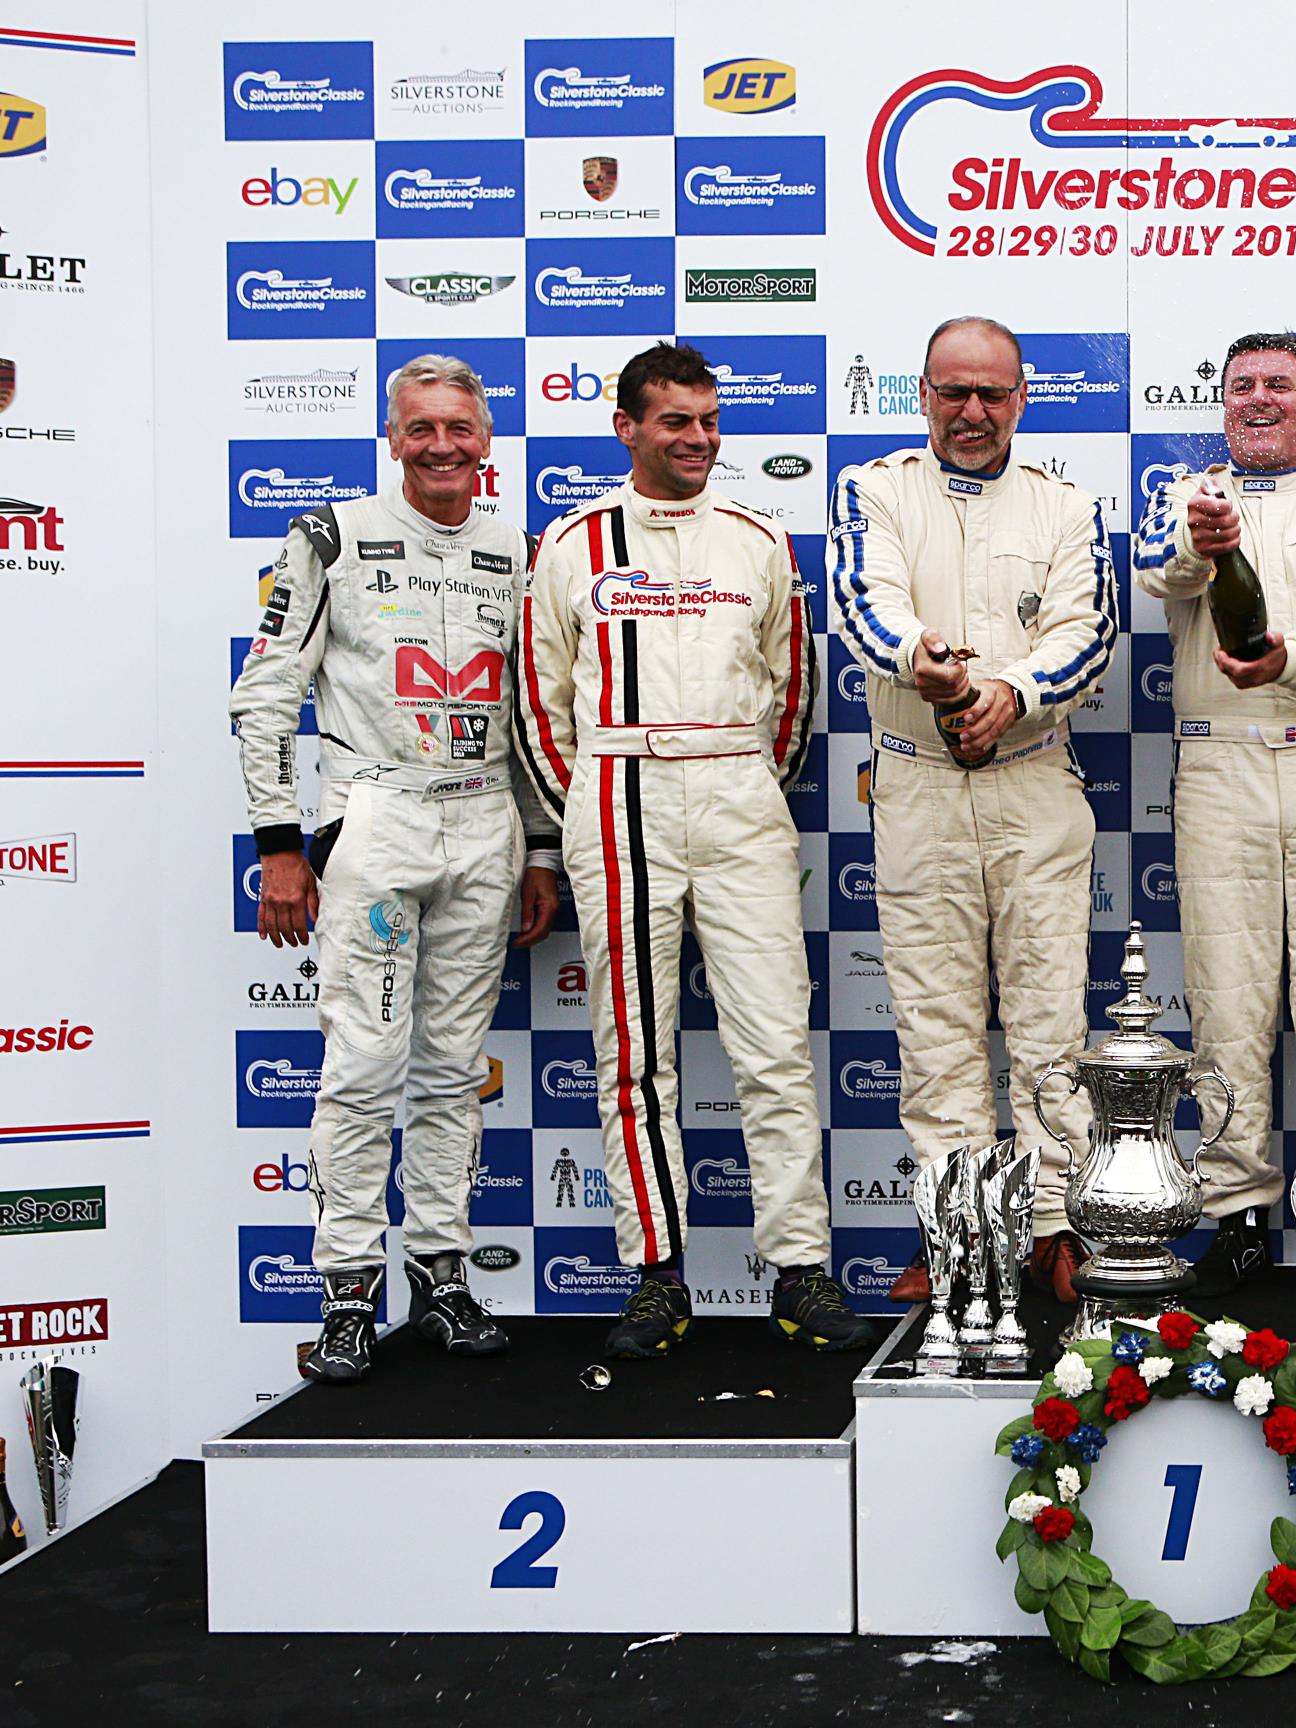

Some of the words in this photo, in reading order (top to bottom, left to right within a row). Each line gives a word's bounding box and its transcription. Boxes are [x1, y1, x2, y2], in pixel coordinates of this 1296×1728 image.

[391, 84, 504, 99] SILVERSTONE
[550, 84, 665, 98] SilverstoneClassic
[713, 73, 785, 99] JET
[249, 88, 364, 102] SilverstoneClassic
[413, 104, 483, 113] AUCTIONS
[241, 167, 357, 214] ebay
[400, 186, 515, 200] SilverstoneClassic
[700, 183, 816, 197] SilverstoneClassic
[540, 209, 660, 220] PORSCHE
[1131, 225, 1223, 257] JULY
[0, 254, 86, 284] LET
[17, 284, 54, 293] SINCE
[252, 287, 366, 300] SilverstoneClassic
[410, 278, 491, 296] CLASSIC
[551, 283, 666, 298] SilverstoneClassic
[244, 384, 356, 399] SILVERSTONE
[266, 403, 336, 413] AUCTIONS
[771, 459, 797, 468] LAND
[770, 466, 805, 476] ROVER
[254, 486, 367, 499] SilverstoneClassic
[950, 480, 981, 493] sparco
[1244, 481, 1275, 490] sparco
[28, 557, 65, 575] buy.
[493, 587, 512, 602] VR
[394, 637, 428, 645] LOCKTON
[883, 735, 914, 751] sparco
[480, 1250, 510, 1259] LAND
[480, 1257, 512, 1266] ROVER
[33, 1304, 104, 1340] ROCK
[1161, 1464, 1203, 1561] 1
[490, 1491, 566, 1588] 2
